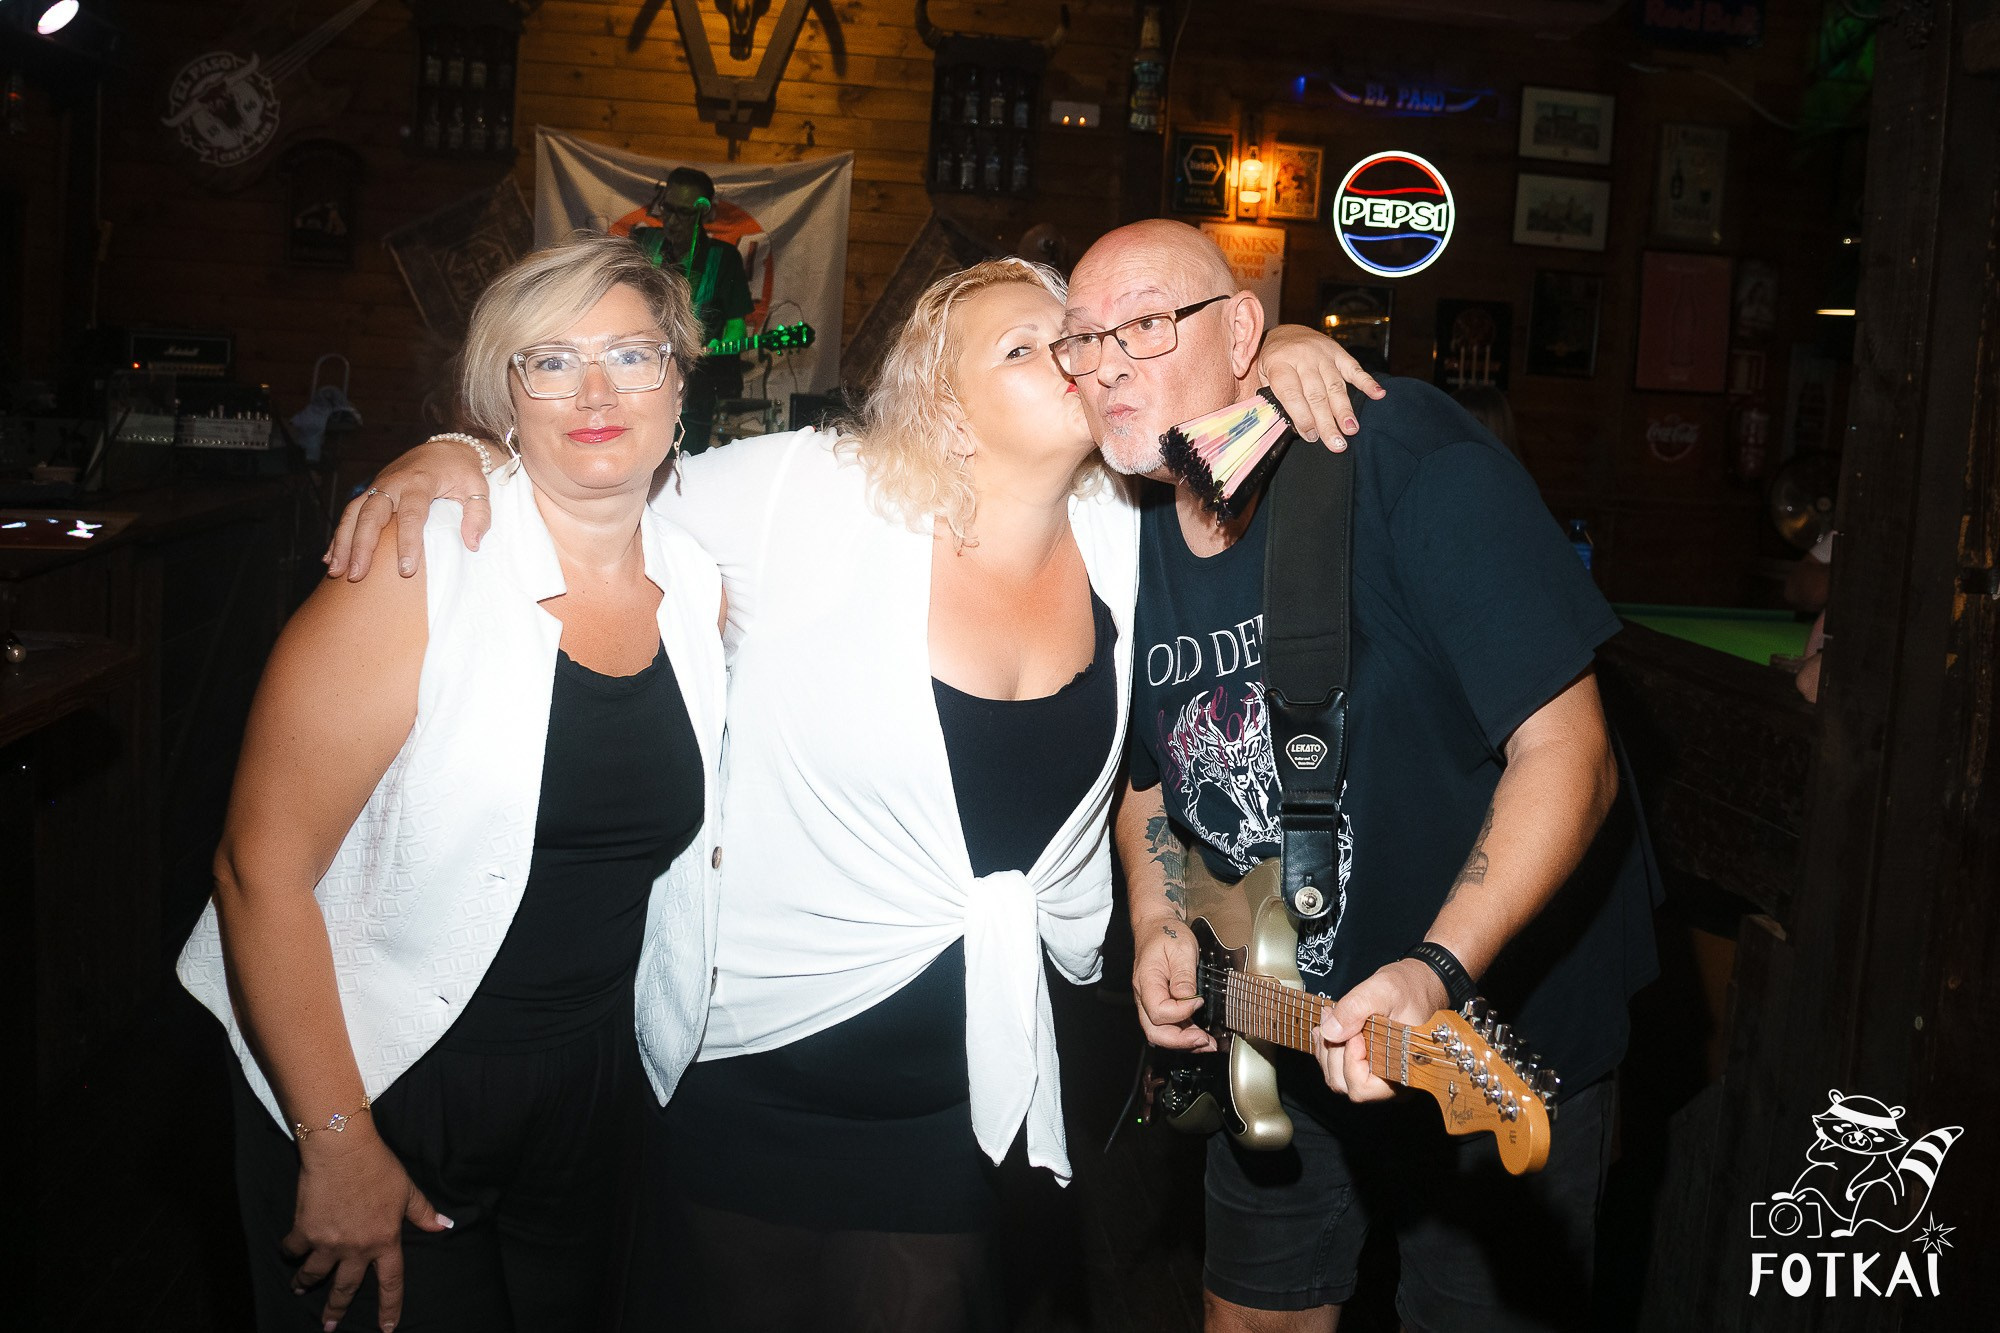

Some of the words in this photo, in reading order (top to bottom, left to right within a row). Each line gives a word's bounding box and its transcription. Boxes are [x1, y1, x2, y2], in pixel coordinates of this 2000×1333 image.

[1364, 83, 1388, 107] EL
[1396, 87, 1445, 112] PASO
[1341, 196, 1448, 232] PEPSI
[1291, 743, 1321, 753] LEKATO
